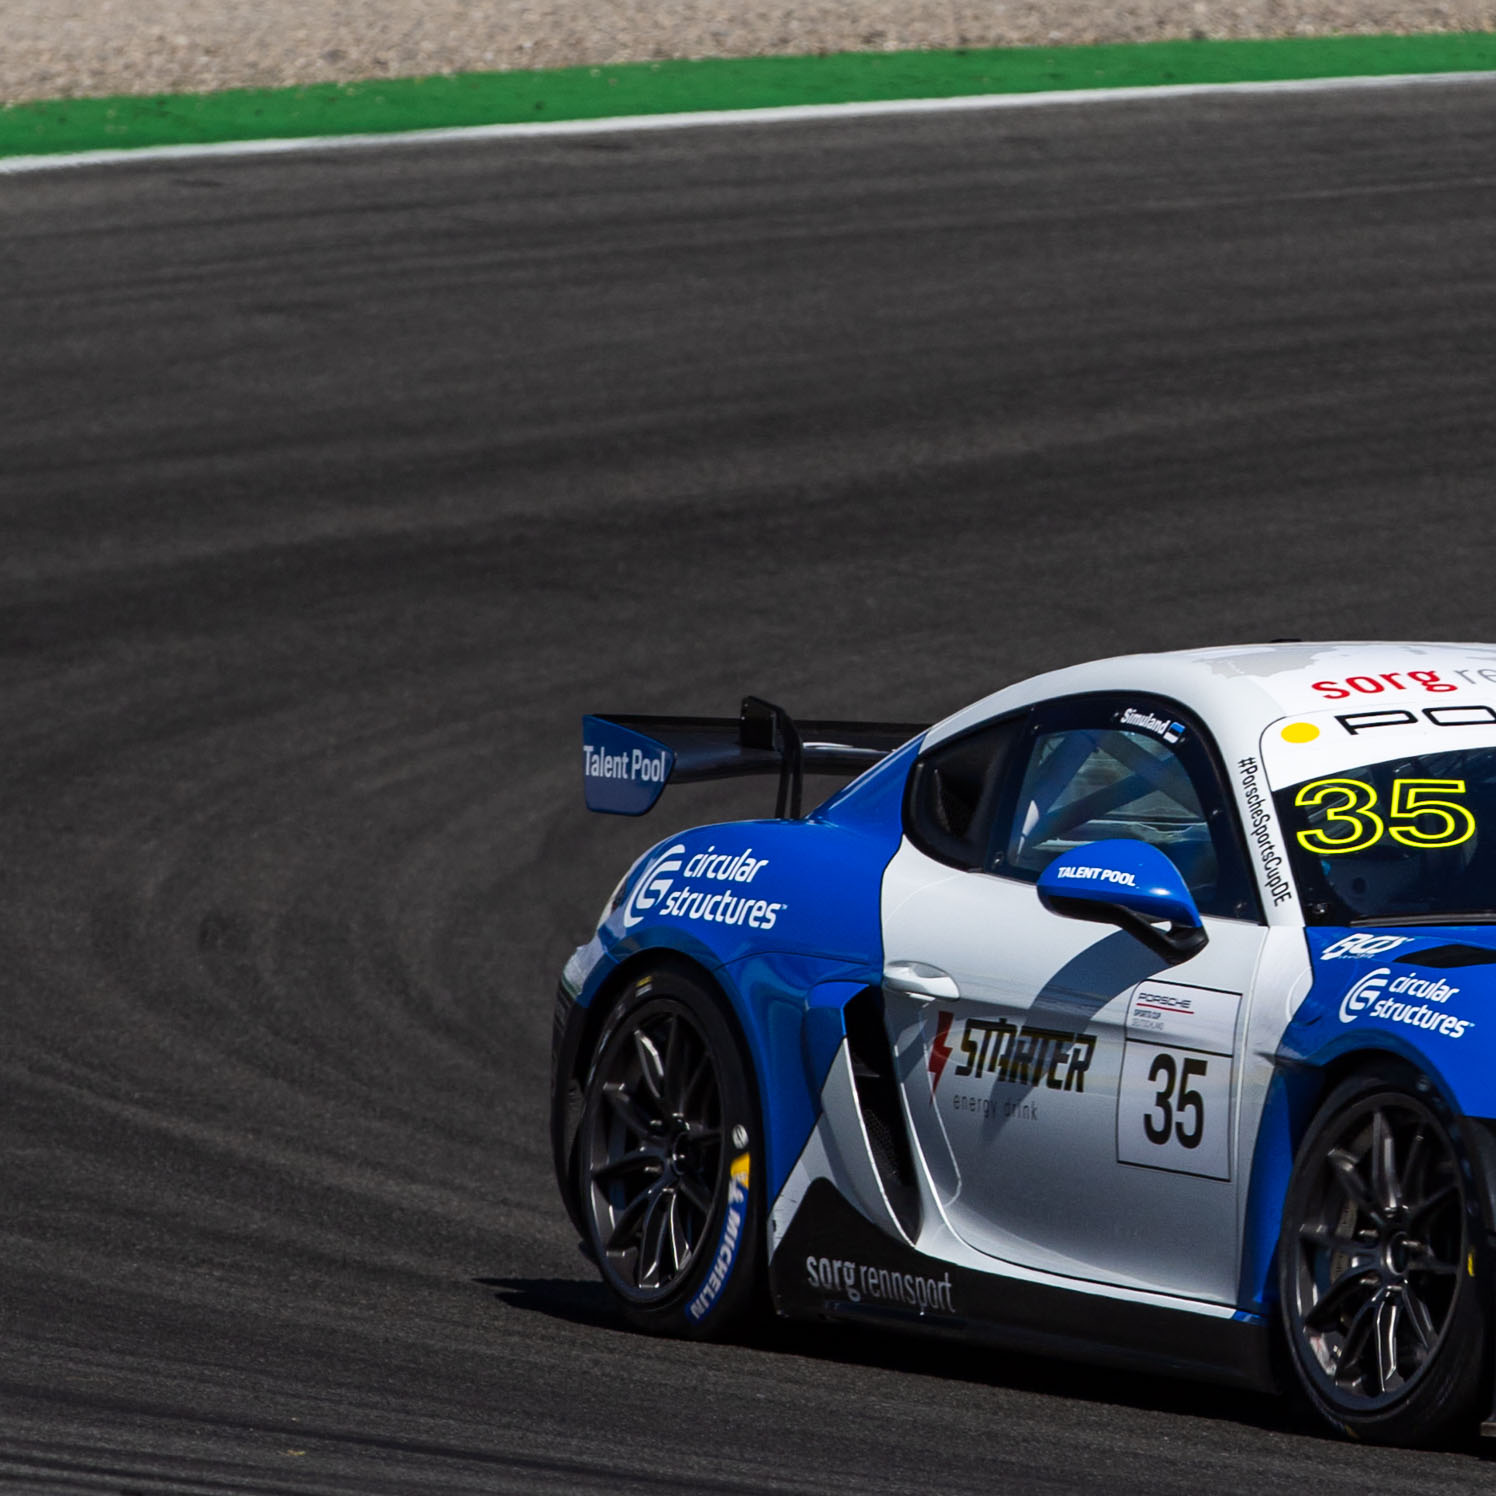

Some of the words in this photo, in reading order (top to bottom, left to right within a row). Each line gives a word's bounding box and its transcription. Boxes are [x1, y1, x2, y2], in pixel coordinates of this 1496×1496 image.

[1311, 670, 1458, 700] sorg
[1120, 708, 1171, 735] Simuland
[583, 745, 628, 779] Talent
[630, 749, 666, 783] Pool
[1237, 756, 1293, 907] #PorscheSportsCupDE
[1295, 778, 1476, 855] 35
[683, 845, 769, 883] circular
[1057, 866, 1101, 880] TALENT
[1100, 868, 1137, 887] POOL
[659, 886, 783, 930] structures
[1138, 992, 1192, 1009] PORSCHE
[1389, 972, 1460, 1003] circular
[1369, 997, 1470, 1038] structures
[954, 1017, 1097, 1093] STARTER
[1143, 1053, 1208, 1150] 35
[690, 1207, 742, 1320] MICHELIN
[806, 1255, 861, 1302] sorg
[860, 1265, 955, 1313] rennsport
